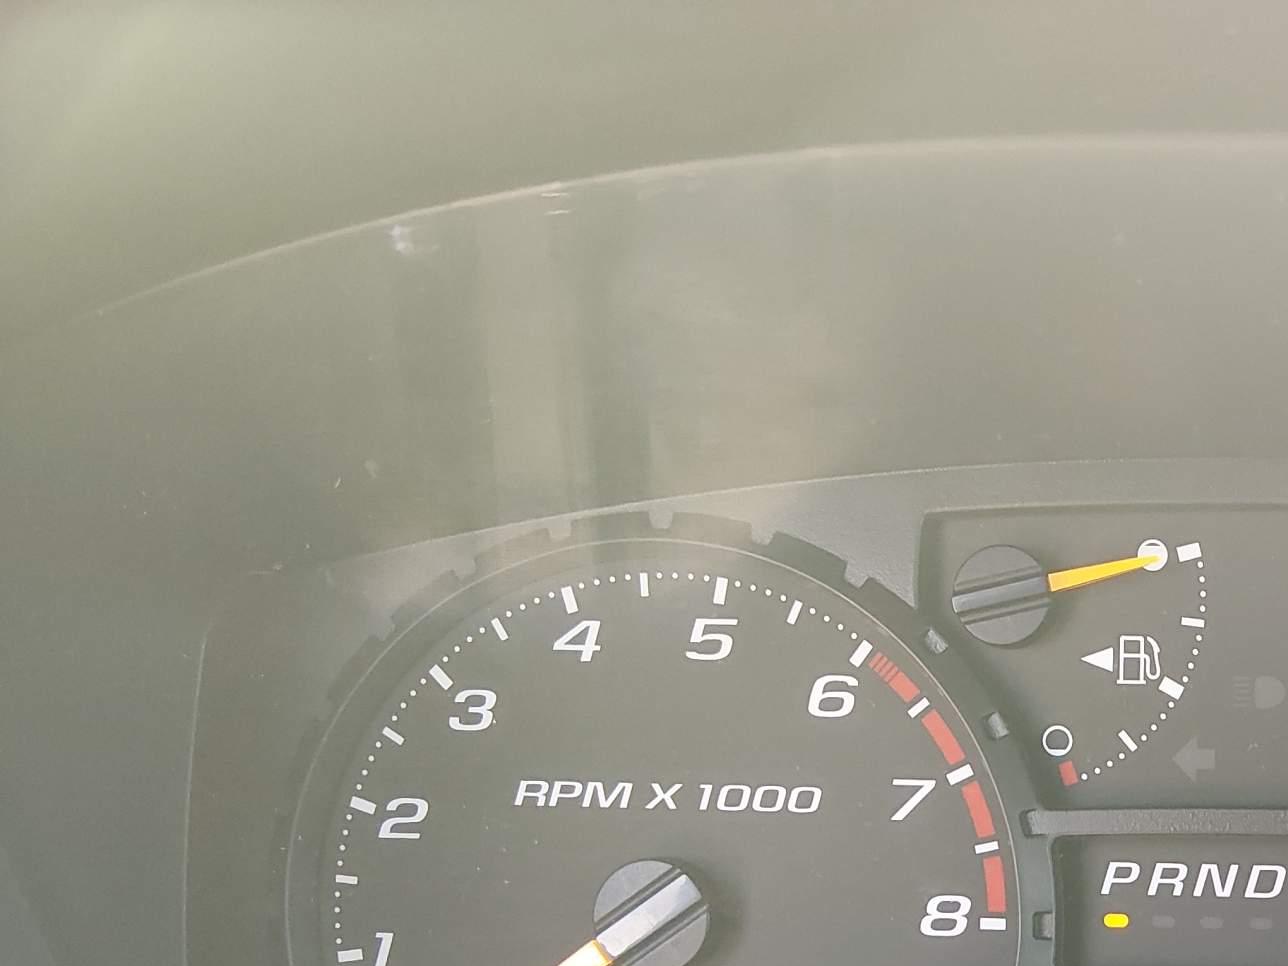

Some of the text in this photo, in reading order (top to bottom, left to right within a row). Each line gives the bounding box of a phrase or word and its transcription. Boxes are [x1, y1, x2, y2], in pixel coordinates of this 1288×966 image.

[552, 620, 601, 662] 4
[685, 618, 739, 661] 5
[447, 689, 496, 732] 3
[807, 674, 859, 718] 6
[378, 797, 429, 839] 2
[514, 780, 822, 813] RPM X 1000
[890, 778, 937, 821] 7
[919, 894, 972, 937] 8
